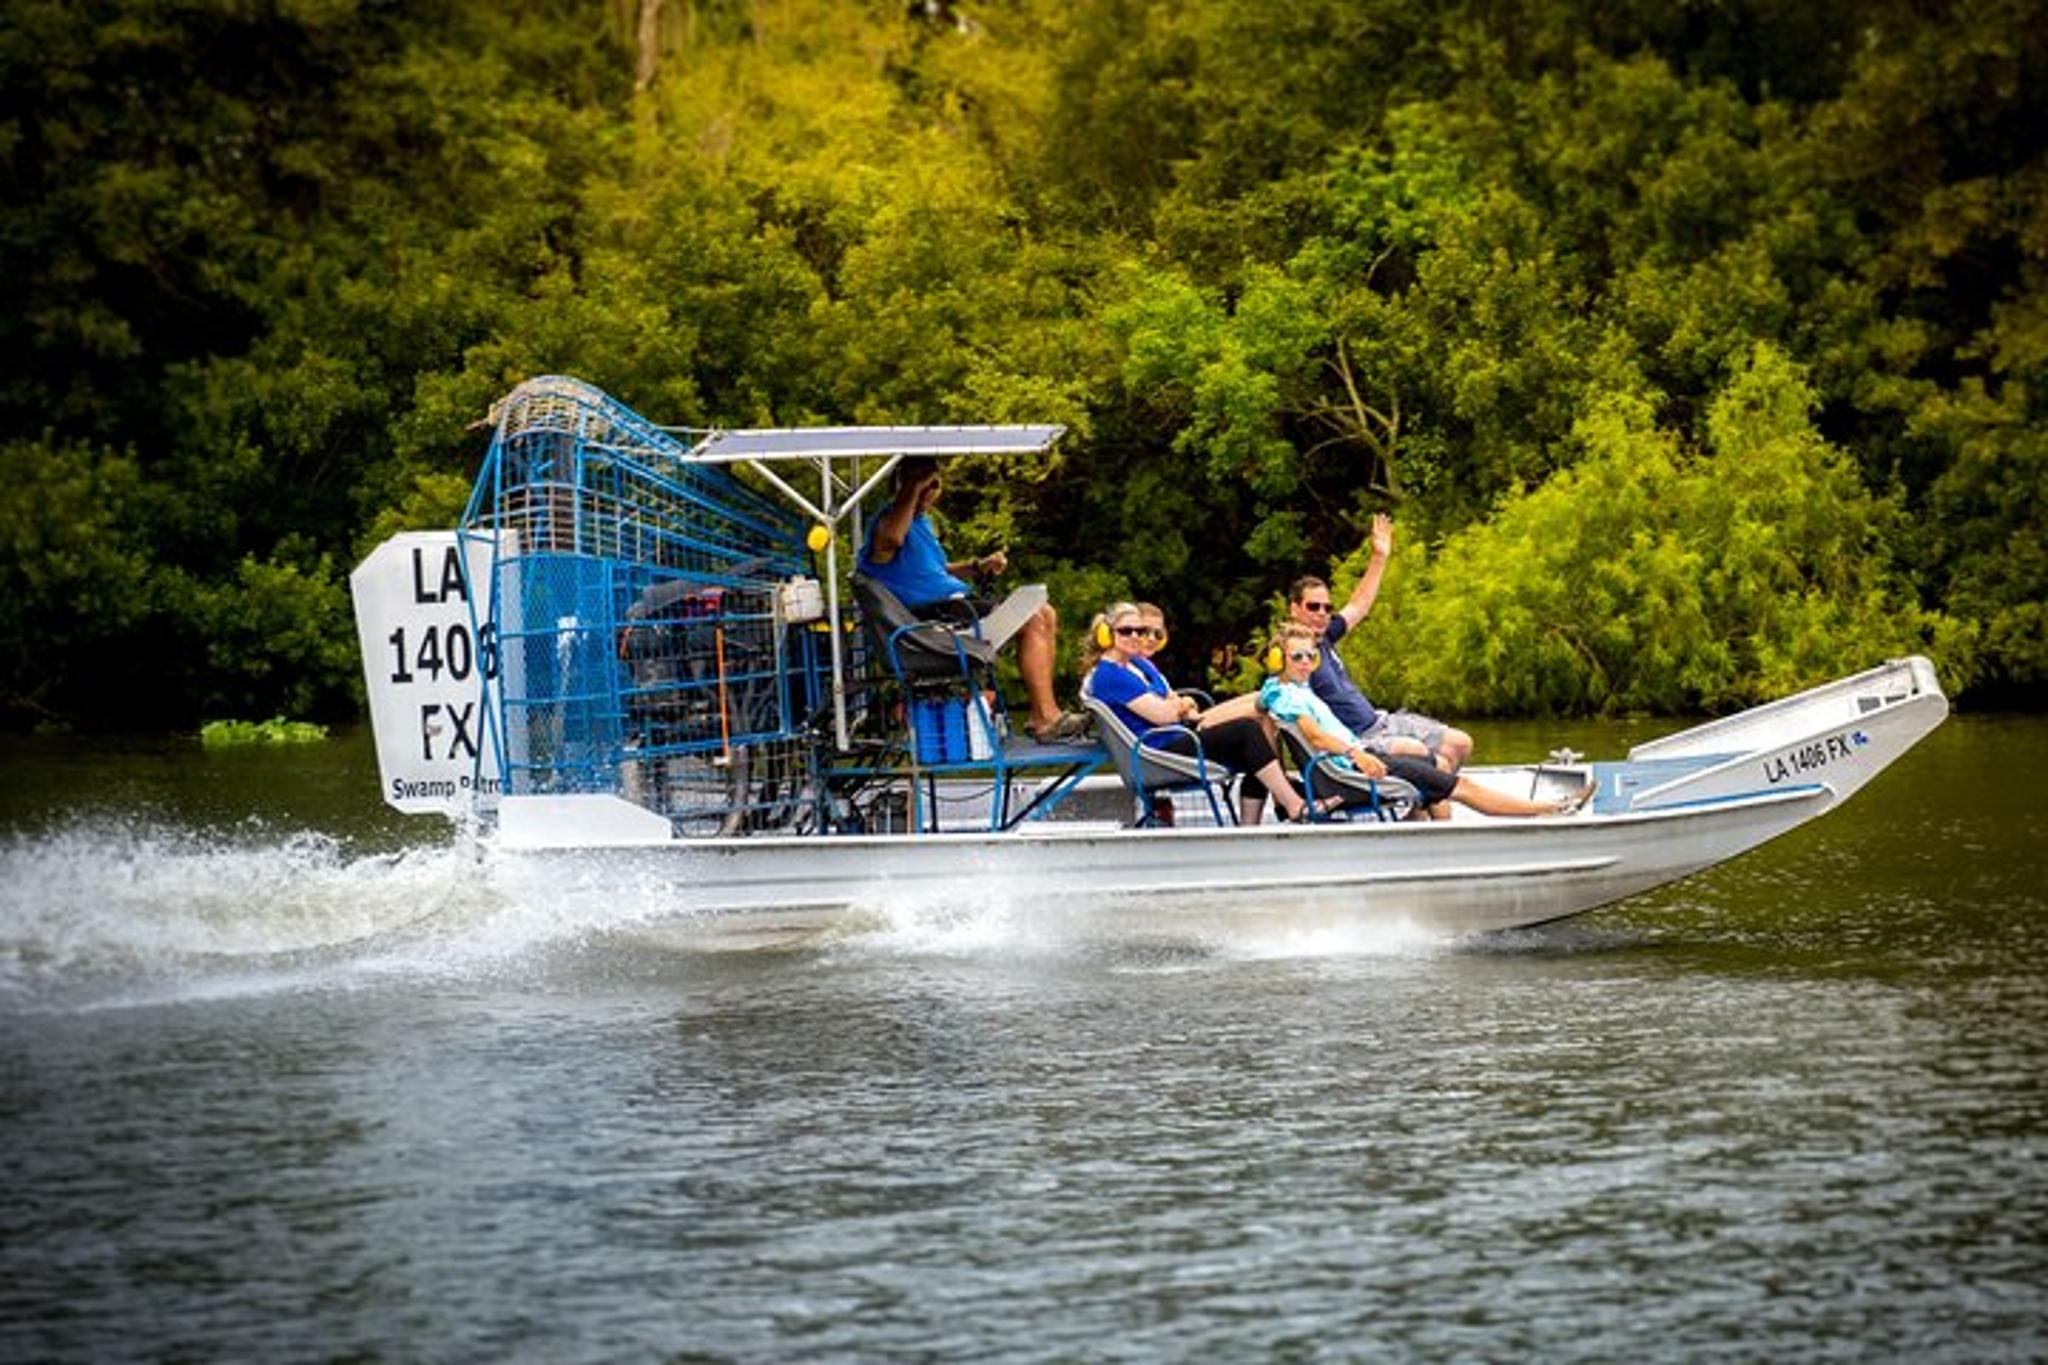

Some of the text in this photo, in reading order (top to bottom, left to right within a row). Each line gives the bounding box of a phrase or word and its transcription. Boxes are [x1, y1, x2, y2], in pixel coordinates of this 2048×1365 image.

[413, 546, 468, 603] LA
[421, 702, 477, 760] FX
[1763, 735, 1852, 783] LA 1406 FX
[392, 778, 456, 801] Swamp
